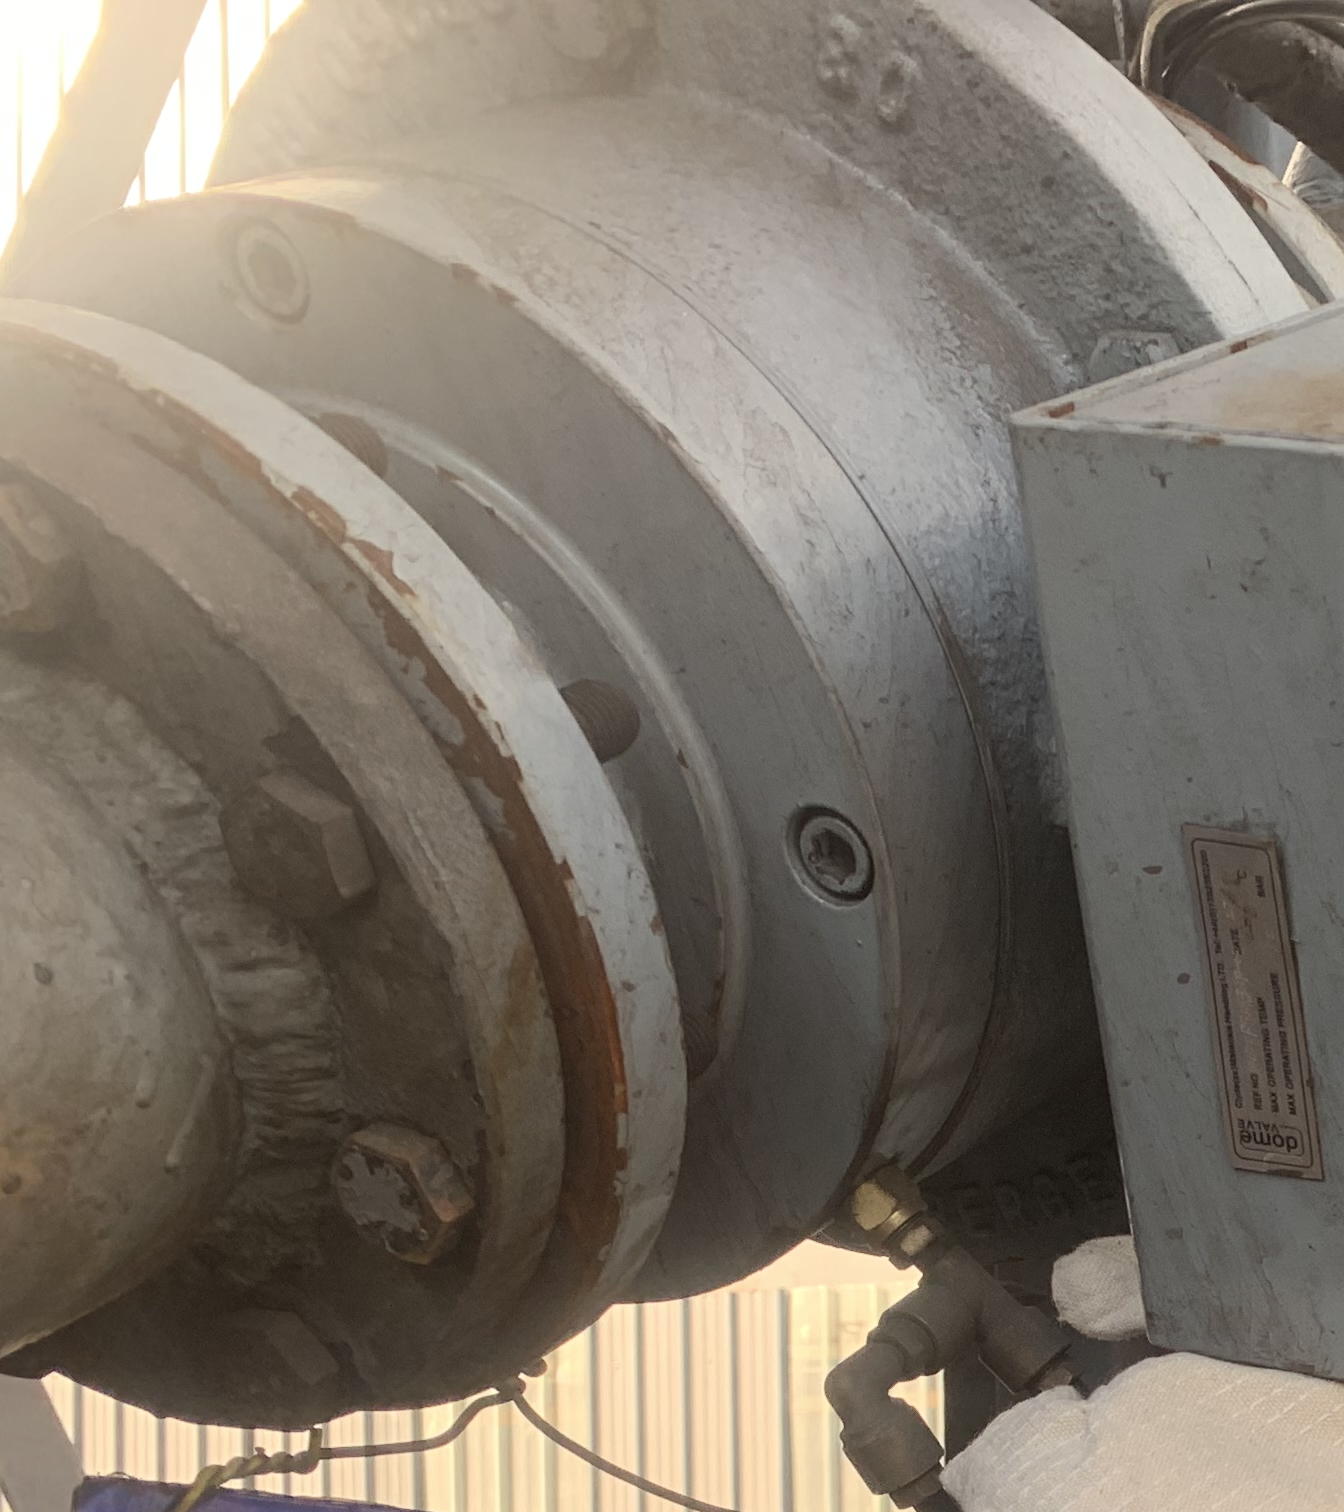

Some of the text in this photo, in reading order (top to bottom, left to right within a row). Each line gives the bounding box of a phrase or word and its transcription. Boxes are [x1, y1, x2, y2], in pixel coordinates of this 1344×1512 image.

[1253, 874, 1297, 1115] MAX OPERATING PRESSURE BAR
[1255, 996, 1267, 1023] TEMP
[1259, 1027, 1276, 1087] OPERATING
[1237, 1118, 1280, 1133] VALVE
[1240, 1130, 1299, 1153] dome
